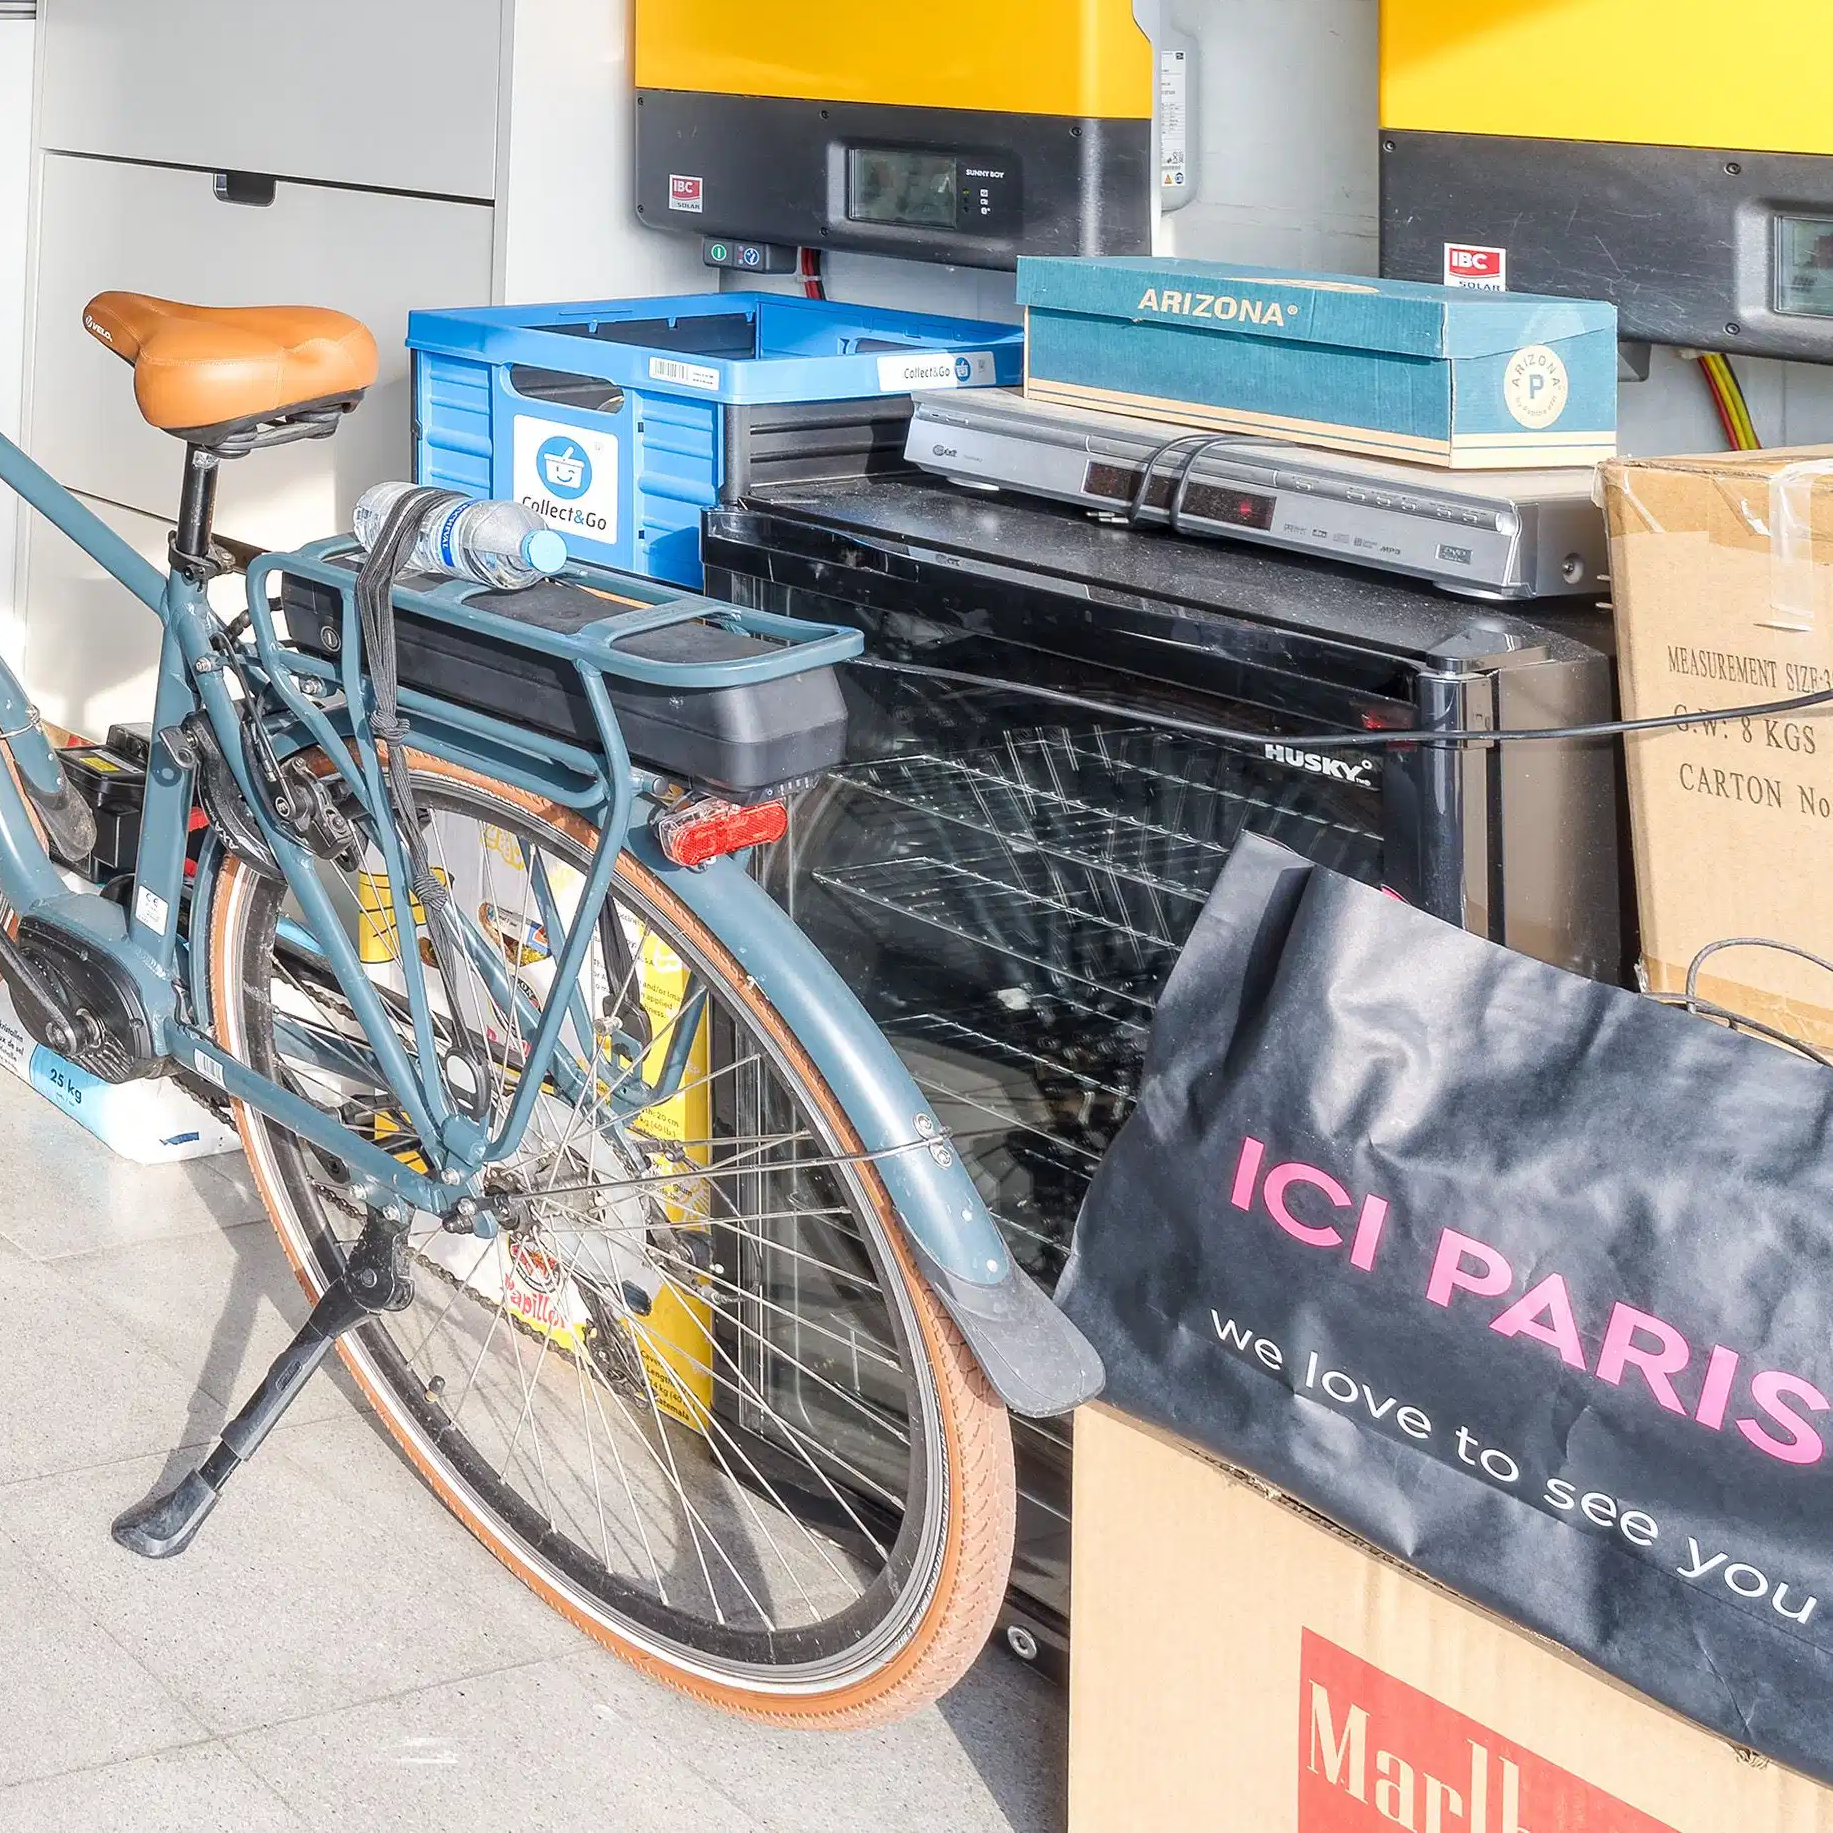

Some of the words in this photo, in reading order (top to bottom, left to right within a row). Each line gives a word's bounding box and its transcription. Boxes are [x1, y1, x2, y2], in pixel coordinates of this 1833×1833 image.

[673, 179, 693, 194] IBC
[966, 169, 989, 178] SUNNY
[990, 170, 1005, 179] BOY
[677, 202, 700, 211] SOLAR
[1451, 251, 1489, 270] IBC
[1458, 280, 1501, 292] SOLAR
[903, 365, 951, 380] Collect&Go
[1528, 373, 1544, 400] P
[521, 496, 608, 531] Collect&Go
[1667, 645, 1777, 688] MEASUREMENT
[1741, 716, 1753, 743] 8
[1764, 718, 1816, 755] KGS
[1264, 743, 1363, 783] HUSKY
[1679, 763, 1782, 809] CARTON
[50, 1068, 64, 1088] 25
[67, 1078, 83, 1105] kg
[1231, 1135, 1389, 1272] ICI
[1425, 1226, 1833, 1465] PARIS
[1209, 1308, 1284, 1371] we
[1304, 1350, 1432, 1441] love
[1454, 1423, 1520, 1484] to
[1542, 1475, 1660, 1547] see
[1676, 1536, 1819, 1624] you
